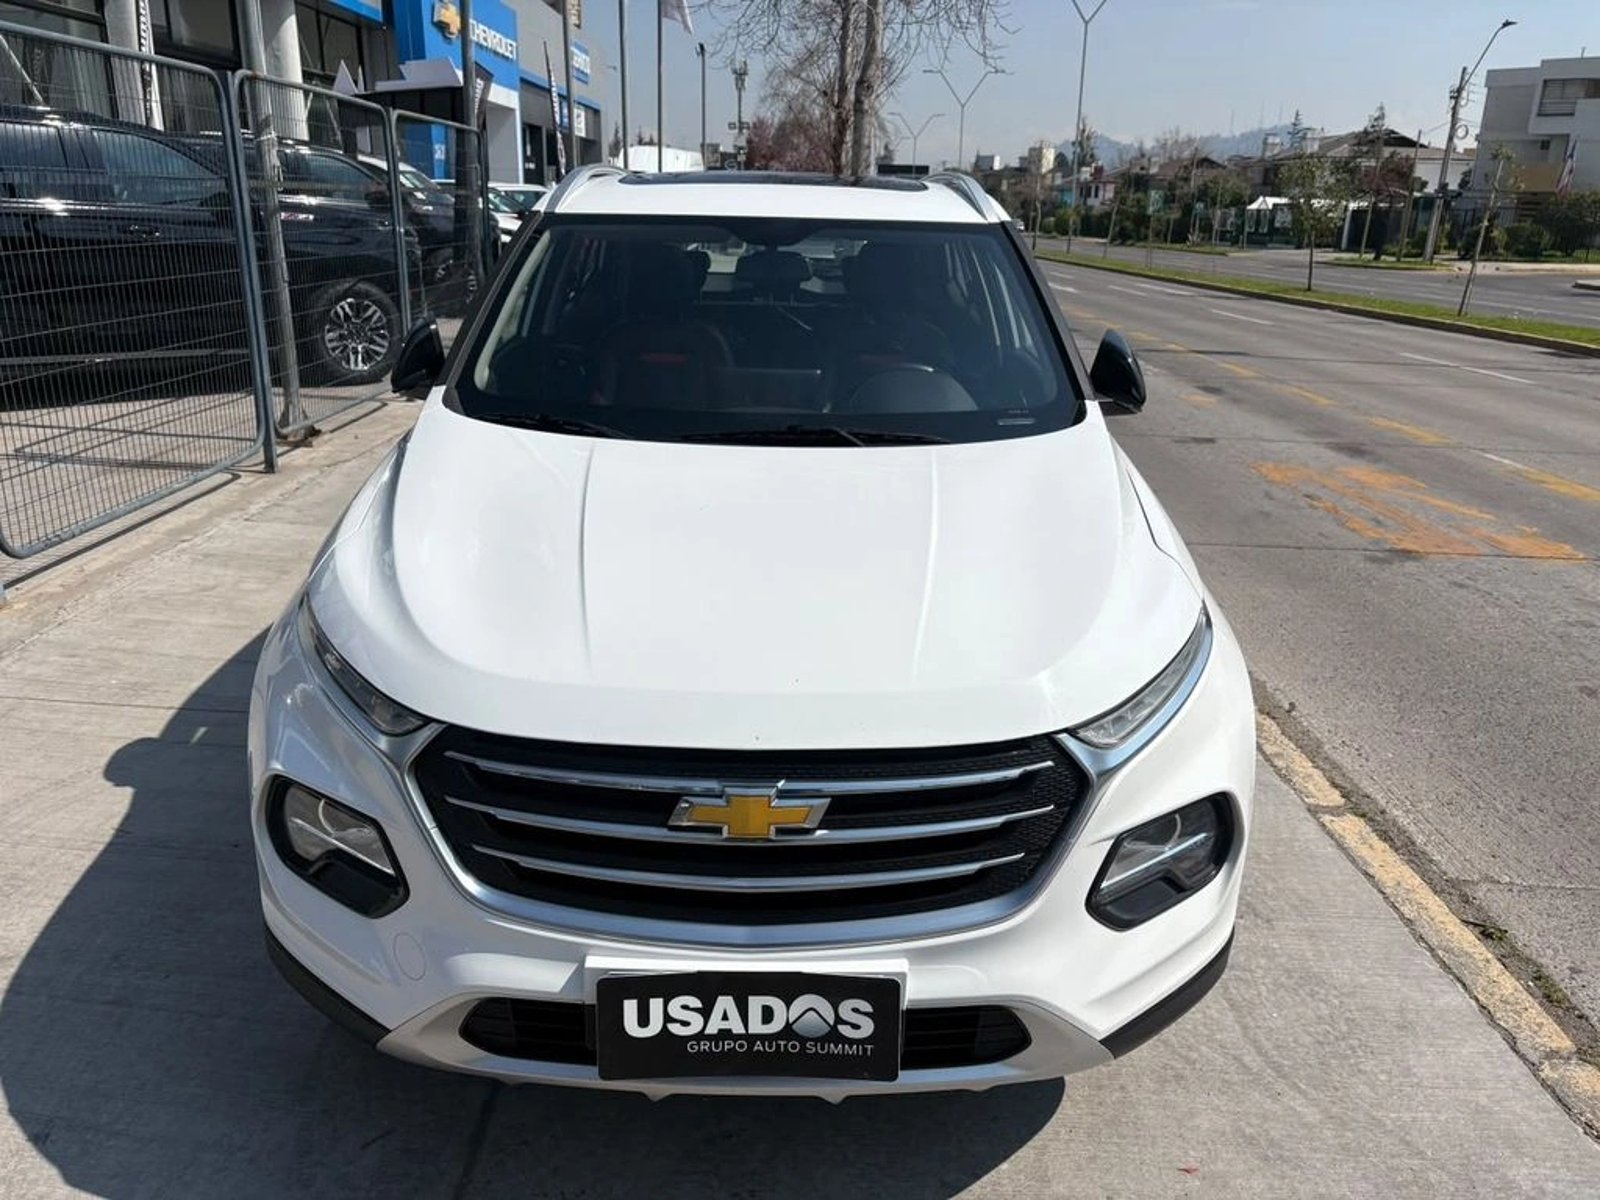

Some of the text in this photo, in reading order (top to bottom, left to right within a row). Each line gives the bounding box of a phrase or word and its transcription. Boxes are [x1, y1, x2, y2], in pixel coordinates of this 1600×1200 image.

[623, 993, 875, 1039] USADOS
[687, 1040, 875, 1057] GRUPO AUTO SUMMIT
